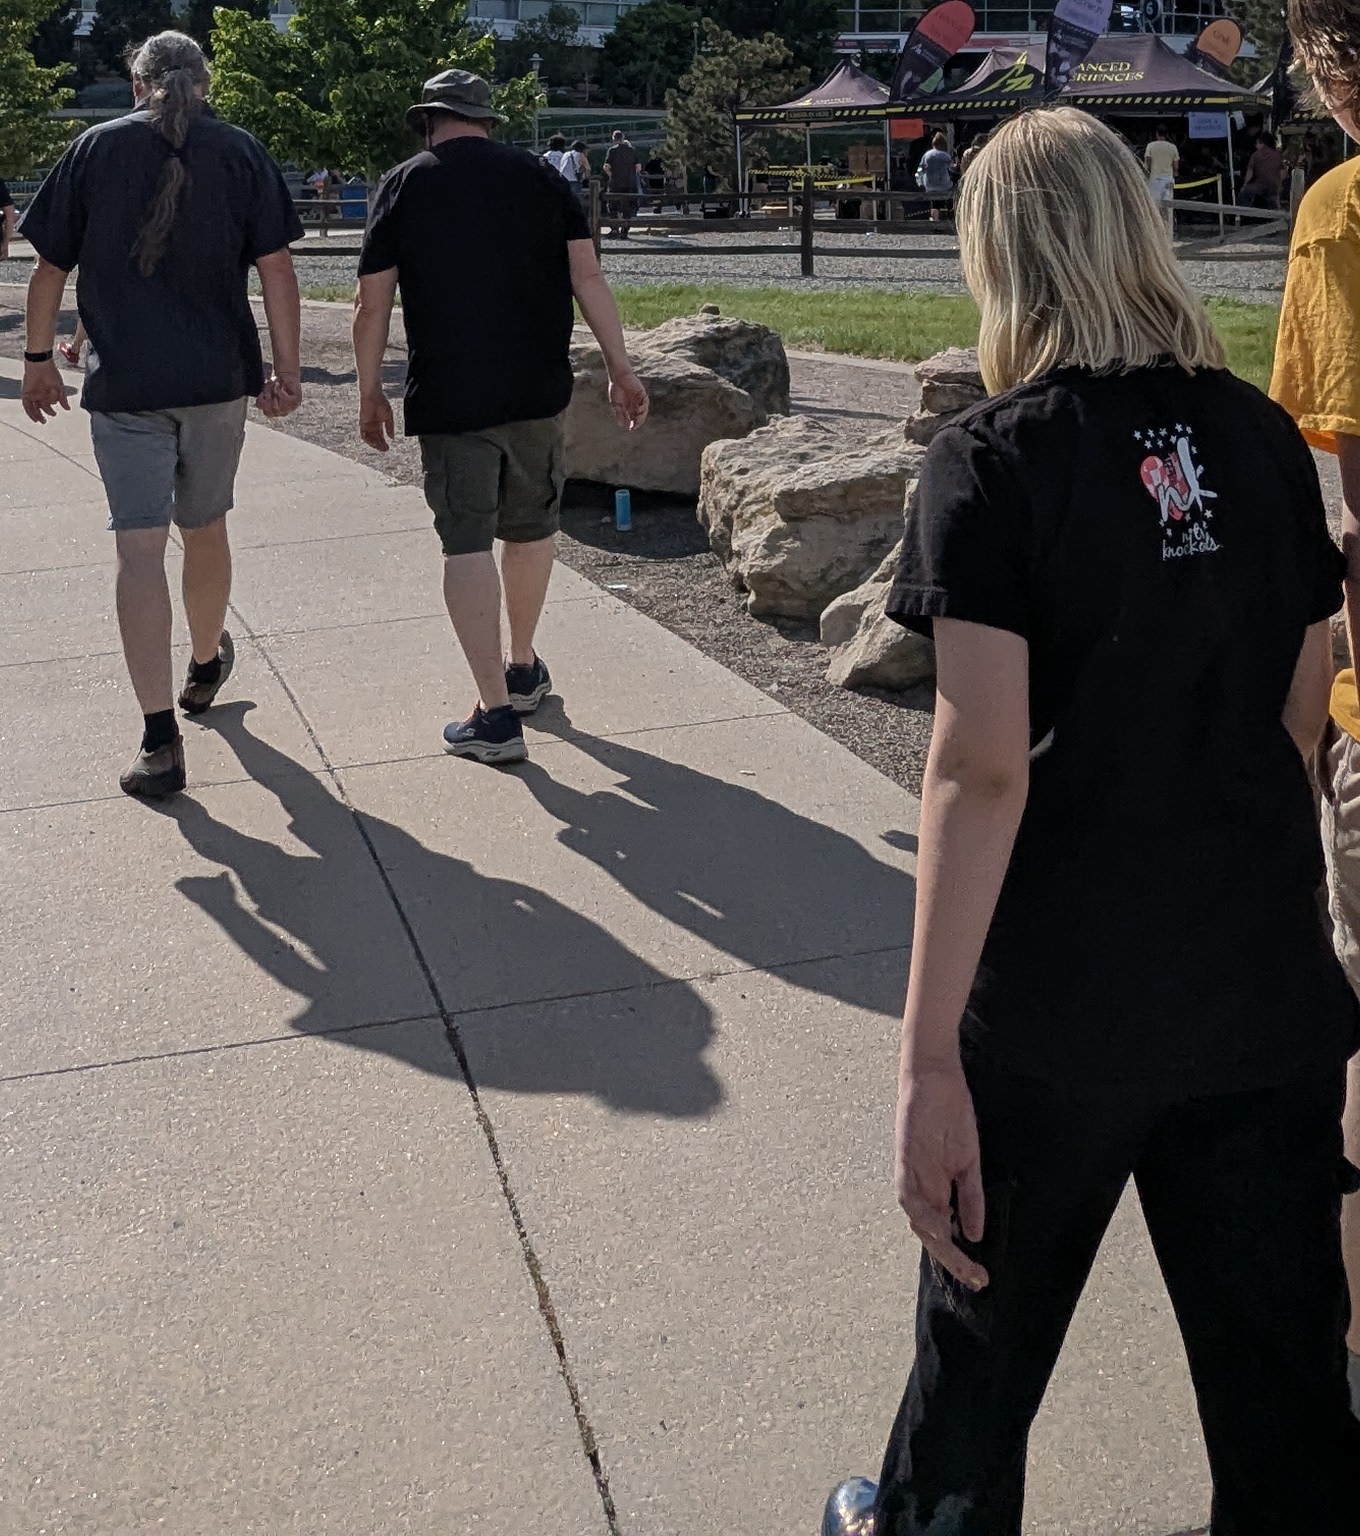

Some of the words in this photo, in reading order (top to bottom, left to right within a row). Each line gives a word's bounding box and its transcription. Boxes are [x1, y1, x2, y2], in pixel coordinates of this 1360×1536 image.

[1145, 2, 1154, 15] 6
[1078, 61, 1131, 72] ANCED
[1071, 72, 1145, 82] RIENCES
